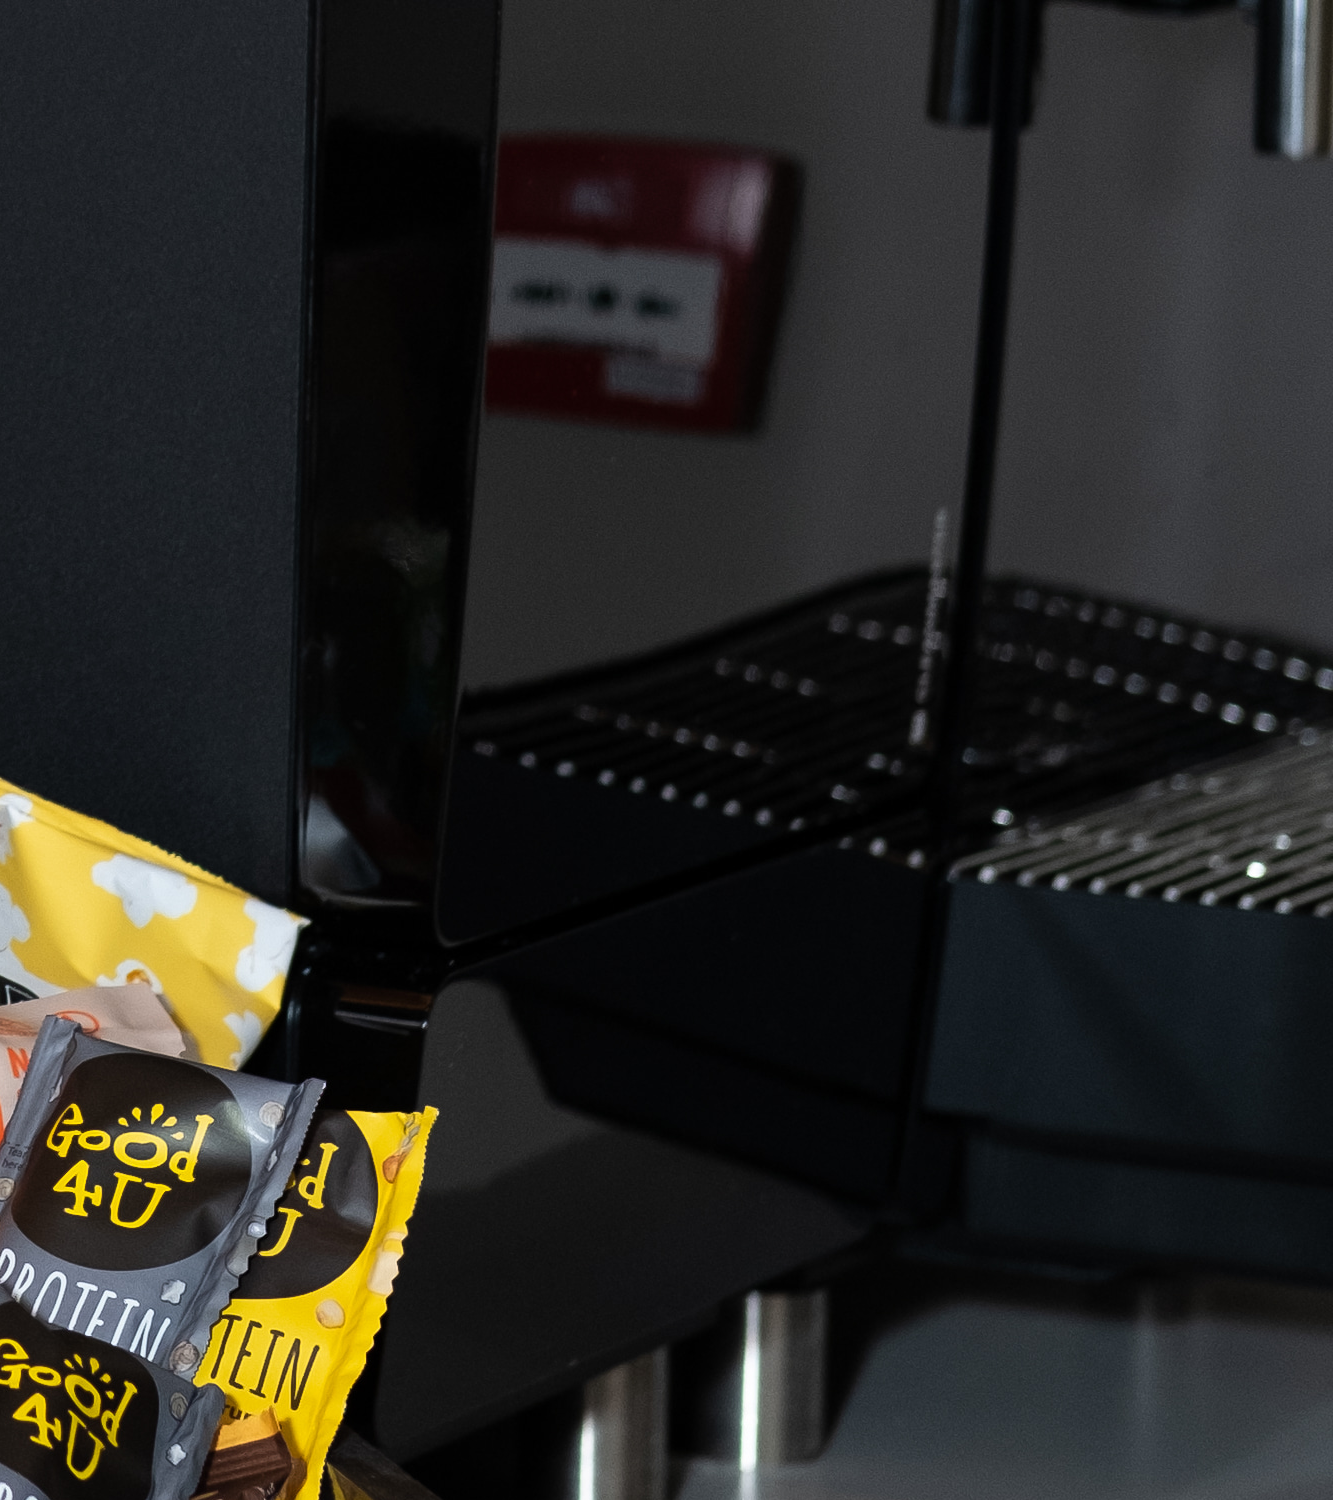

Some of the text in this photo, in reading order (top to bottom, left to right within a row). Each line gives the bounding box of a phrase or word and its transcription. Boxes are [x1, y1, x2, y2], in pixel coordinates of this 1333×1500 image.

[45, 1102, 215, 1183] Good
[52, 1158, 172, 1230] 4U
[210, 1313, 321, 1412] TEIN
[12, 1393, 108, 1481] 4U
